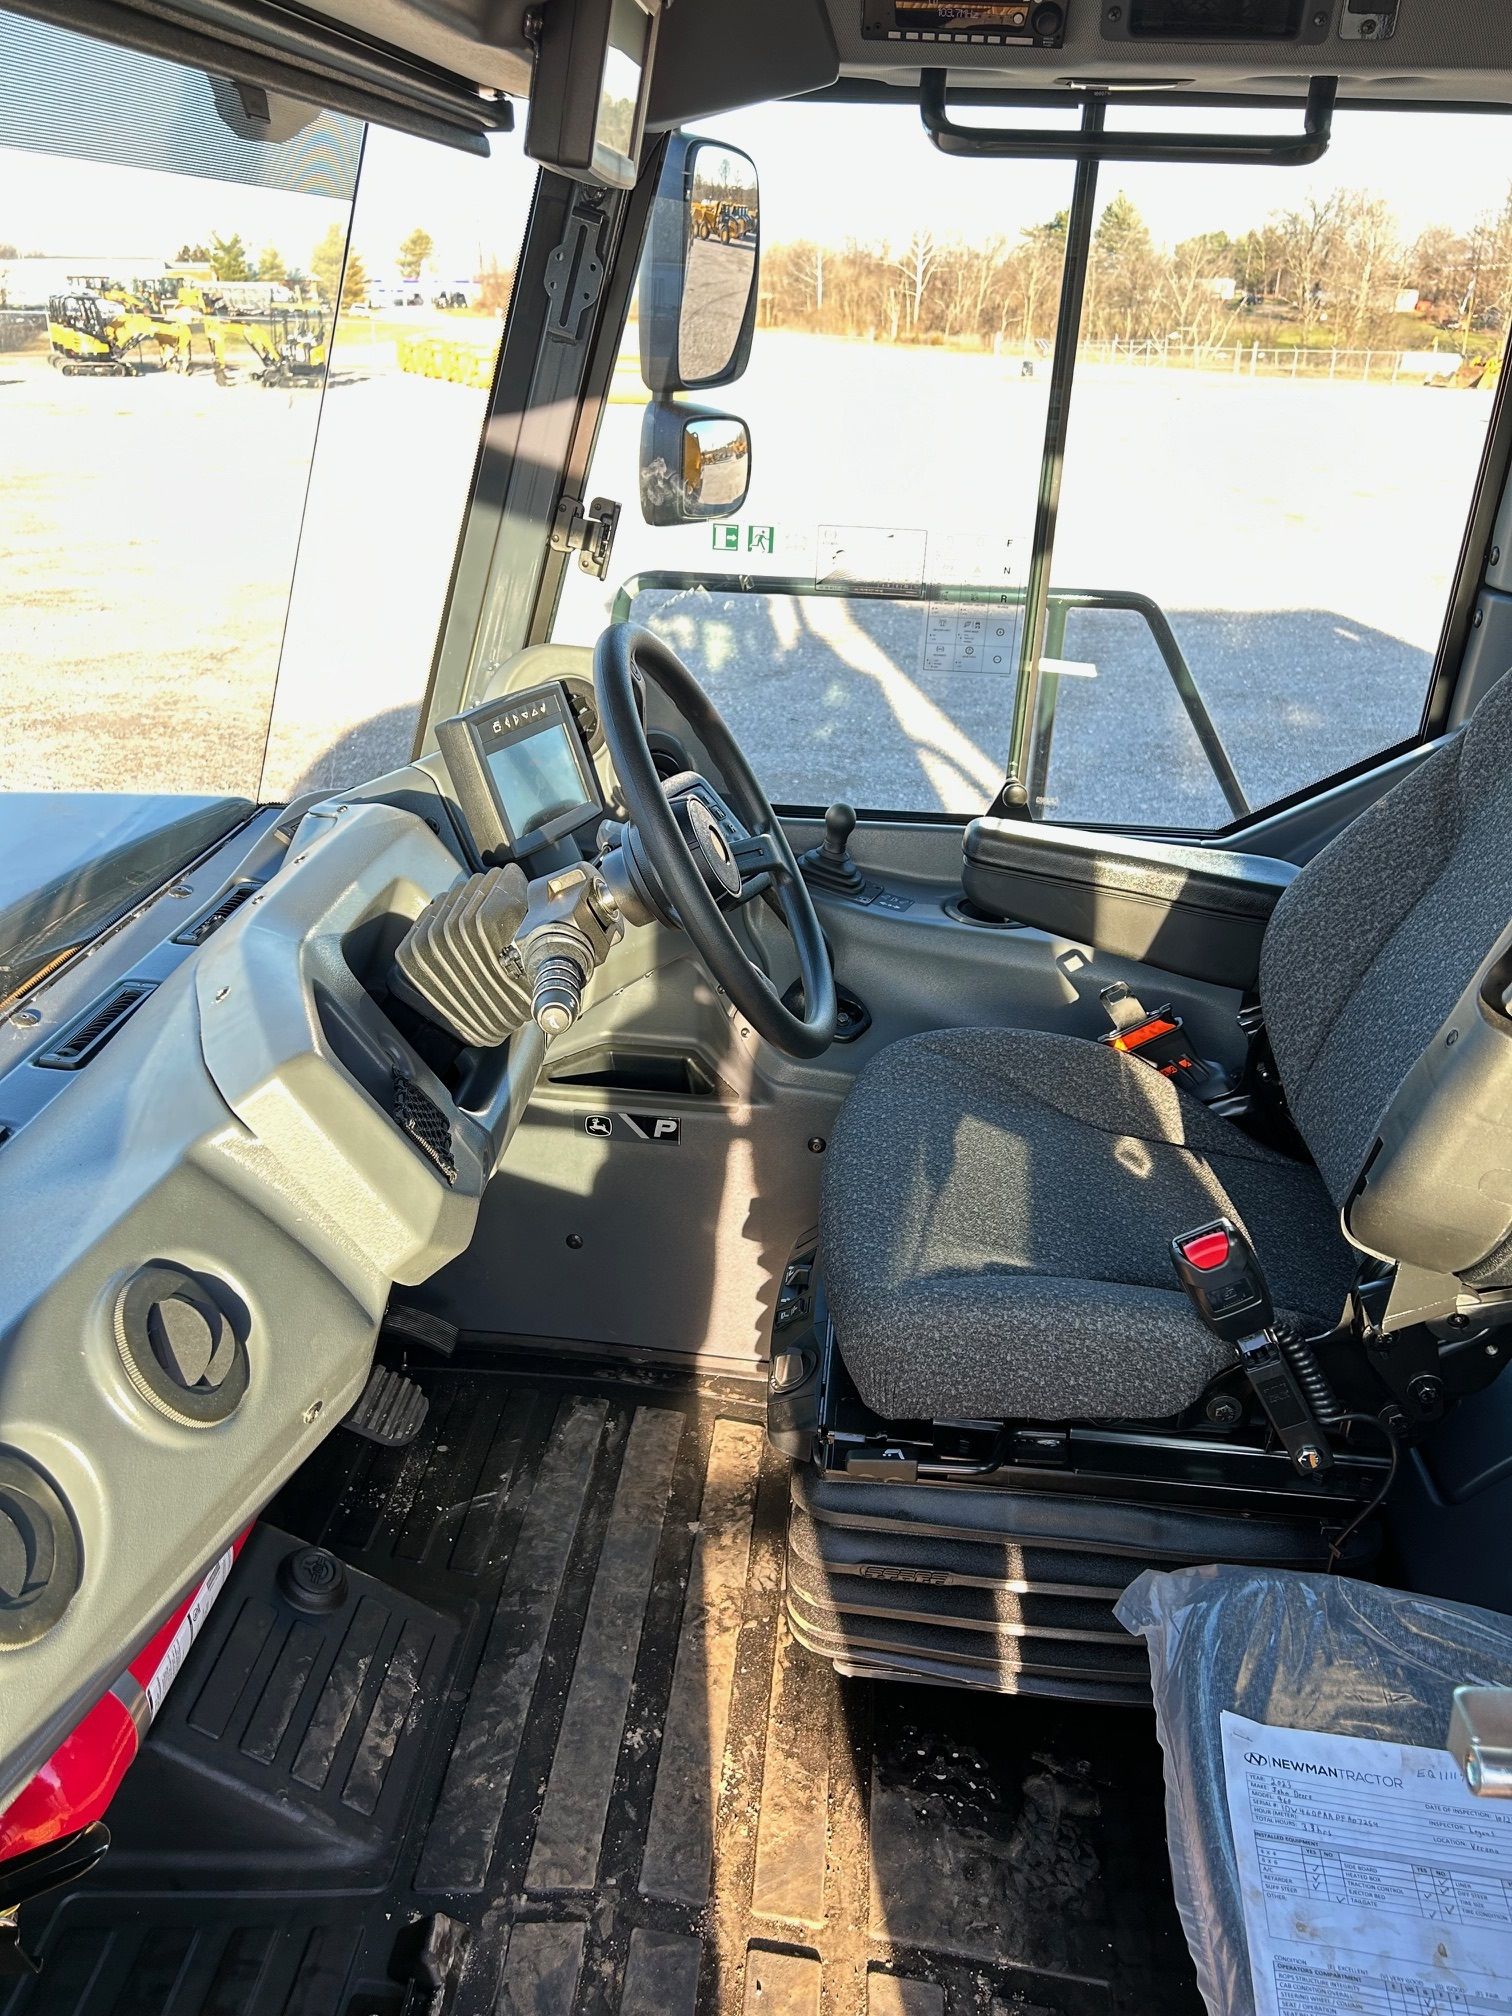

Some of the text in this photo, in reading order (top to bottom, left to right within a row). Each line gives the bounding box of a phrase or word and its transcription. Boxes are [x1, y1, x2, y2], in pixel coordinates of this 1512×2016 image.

[1006, 539, 1014, 548] F
[1003, 566, 1011, 575] N
[1000, 594, 1008, 603] R
